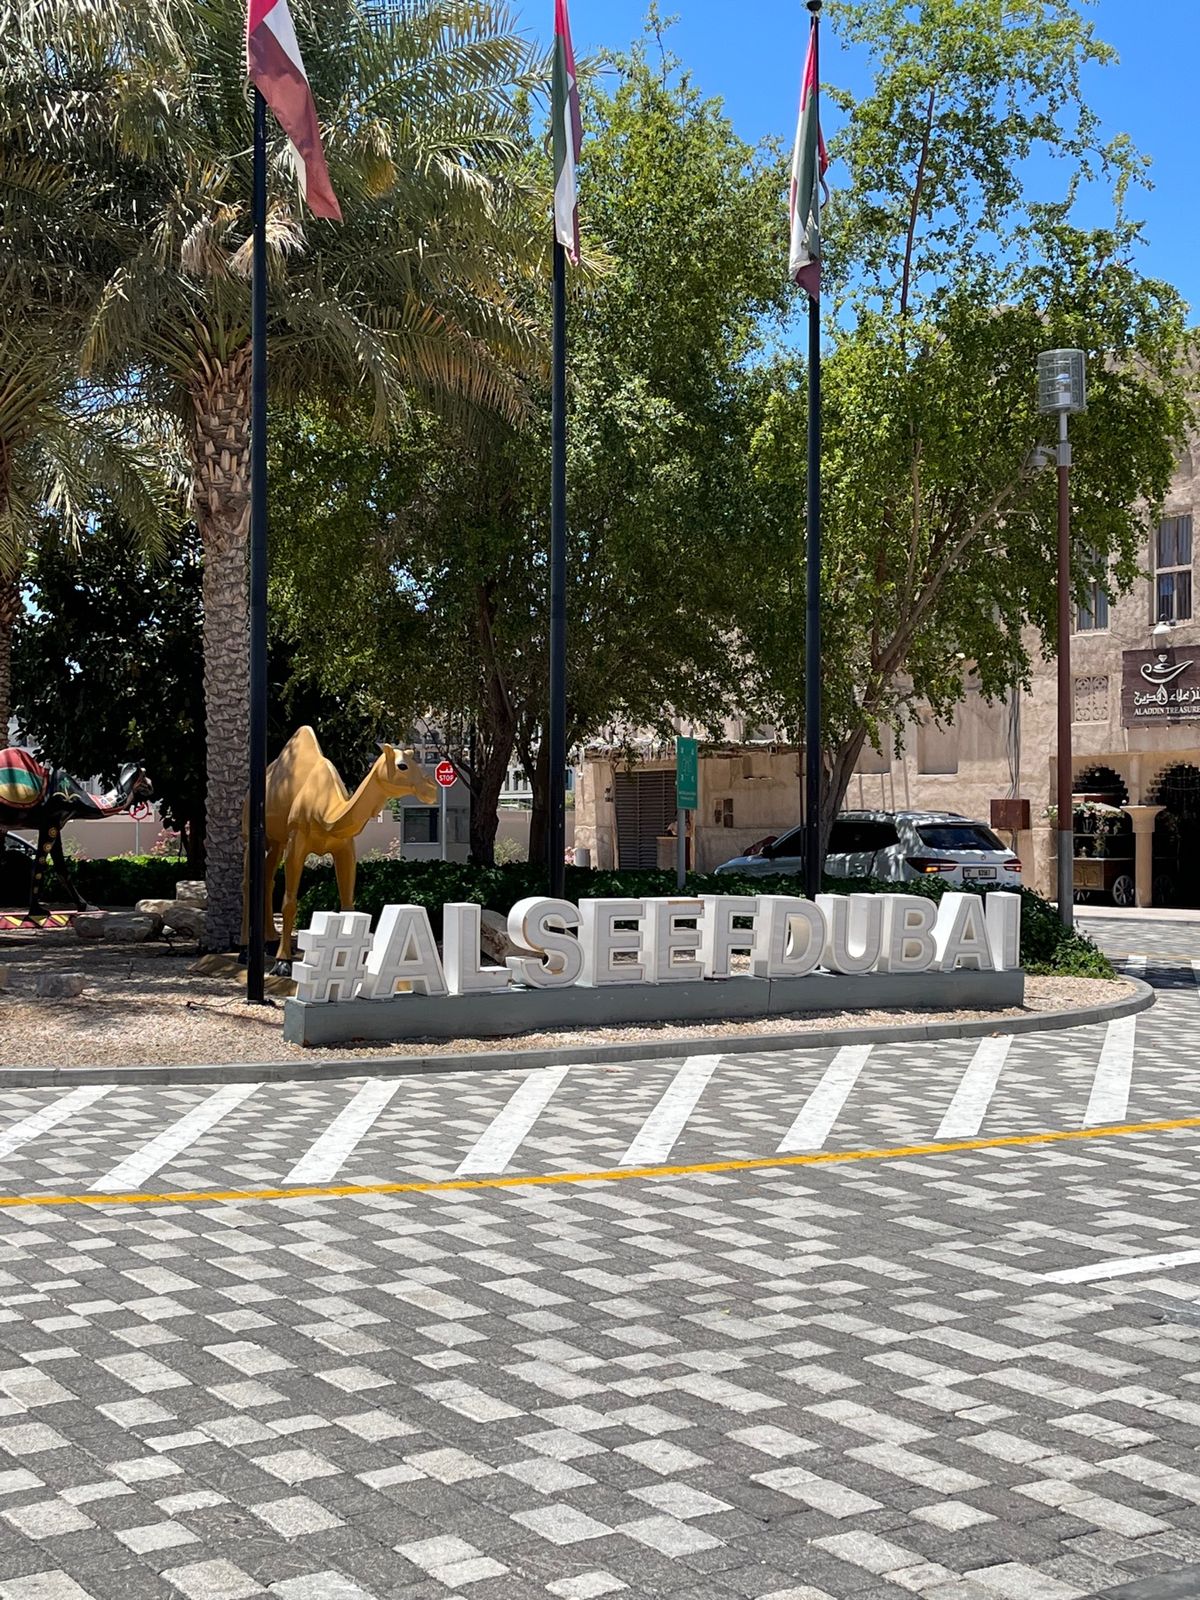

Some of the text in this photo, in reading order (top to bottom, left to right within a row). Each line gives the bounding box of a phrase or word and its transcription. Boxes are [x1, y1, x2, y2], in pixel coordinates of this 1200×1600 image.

[1169, 688, 1190, 703] علاء
[1190, 686, 1200, 702] نز
[1134, 707, 1165, 716] ALADDIN
